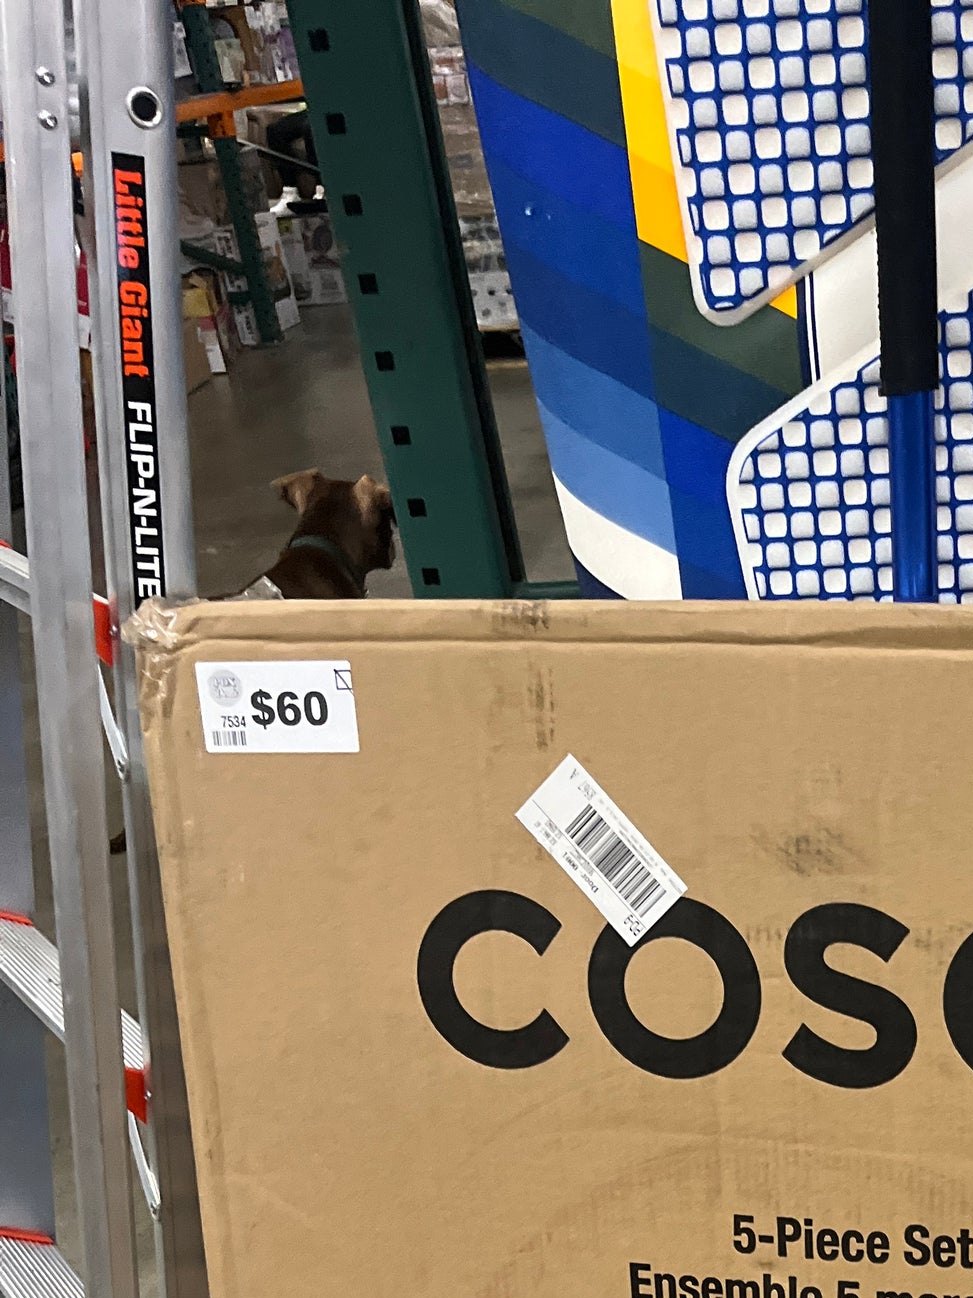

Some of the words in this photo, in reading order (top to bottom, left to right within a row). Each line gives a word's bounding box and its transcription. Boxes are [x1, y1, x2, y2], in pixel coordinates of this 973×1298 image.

[114, 169, 145, 269] Little
[120, 280, 149, 378] Giant
[127, 401, 162, 598] FLIP-N-LITE
[221, 715, 246, 728] 7534
[250, 689, 328, 730] $60
[733, 1214, 890, 1264] 5-Piece
[903, 1224, 973, 1269] Set
